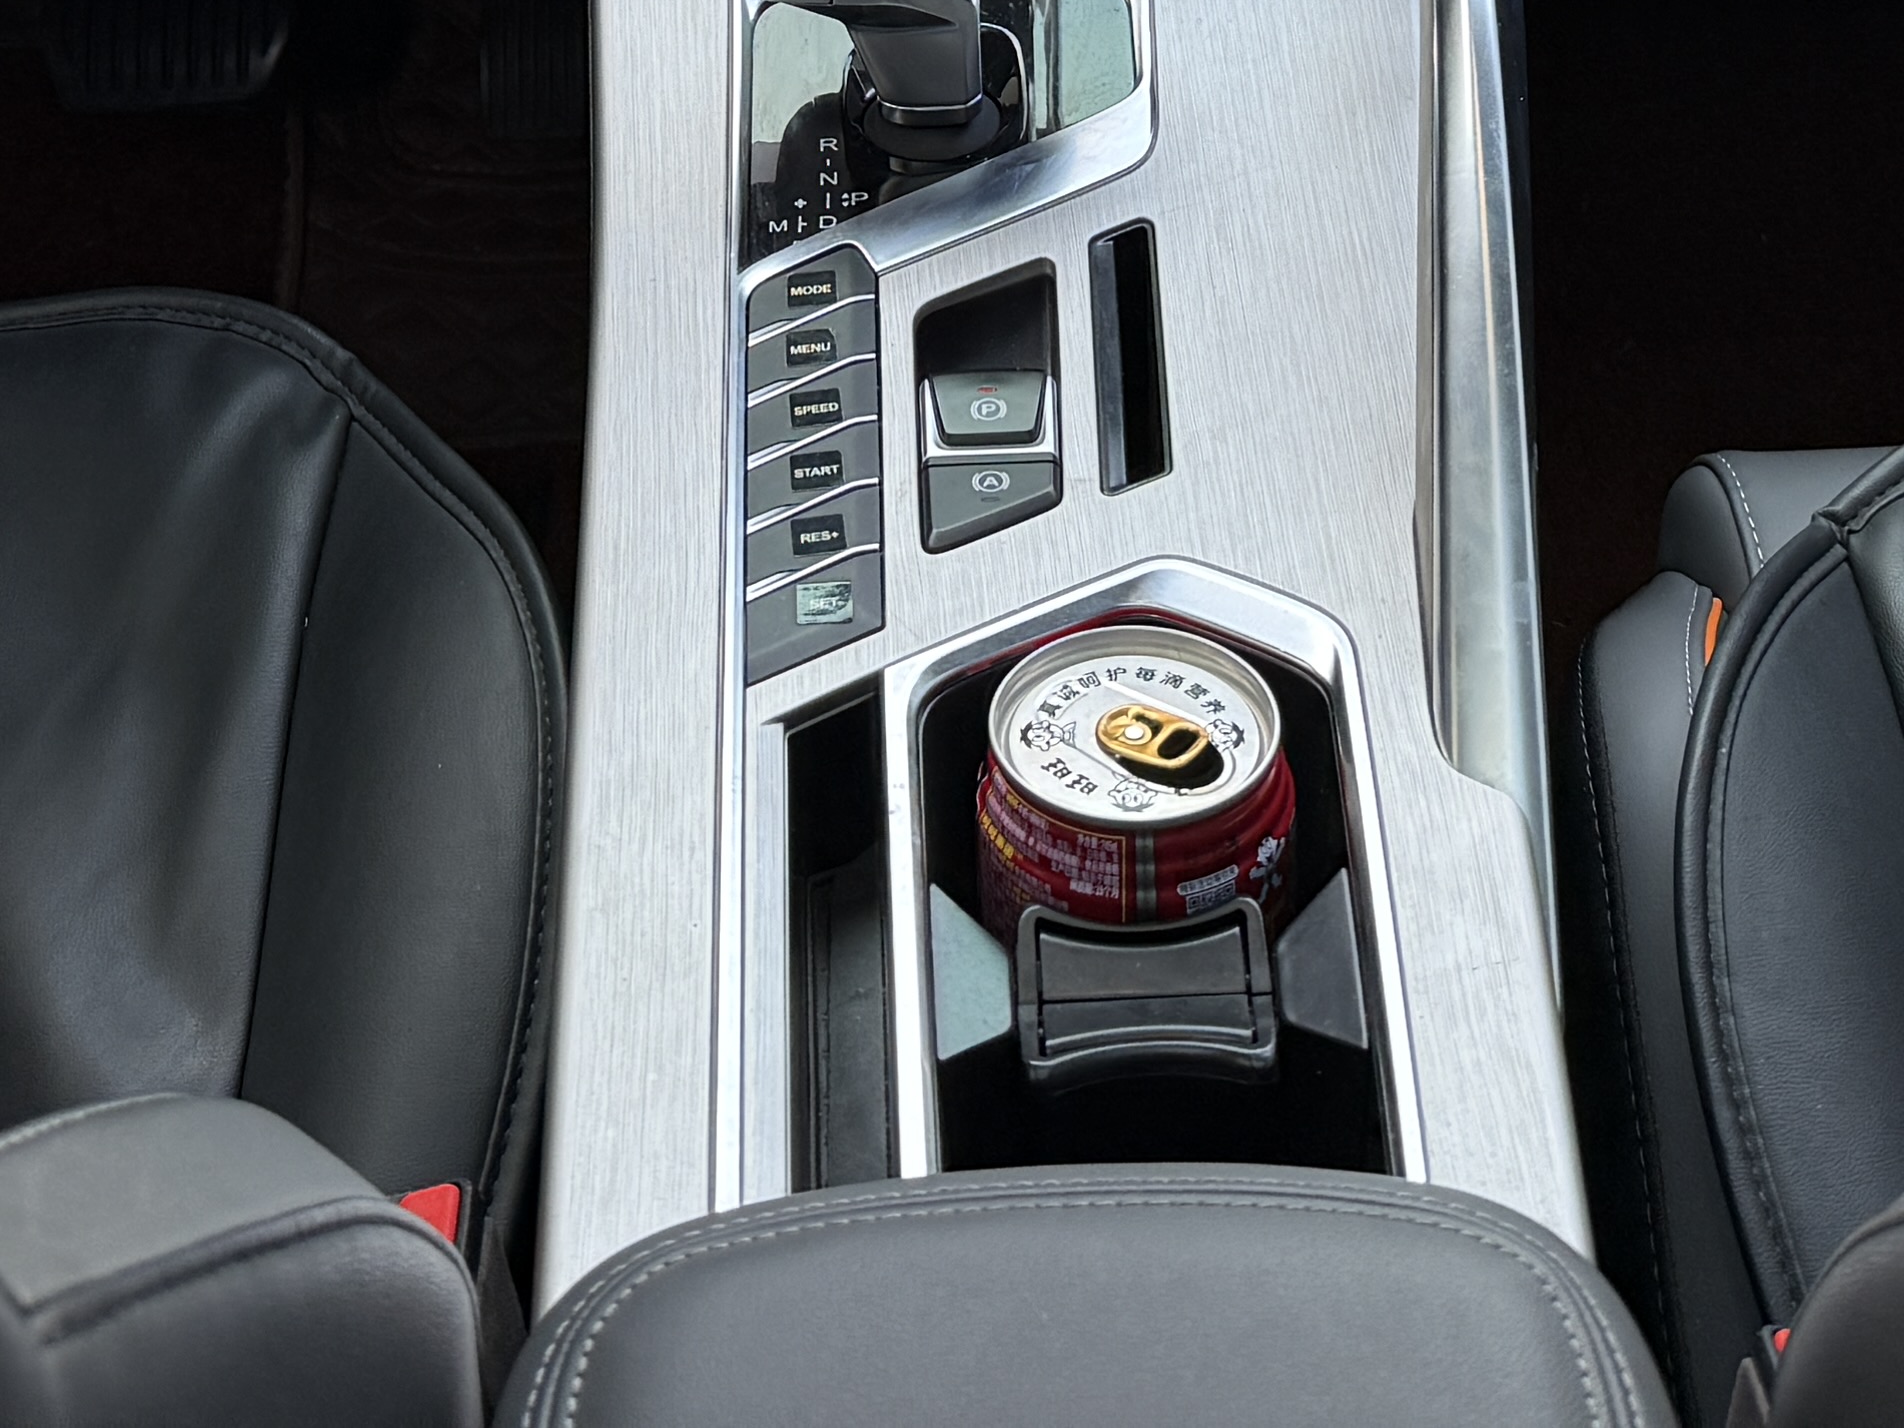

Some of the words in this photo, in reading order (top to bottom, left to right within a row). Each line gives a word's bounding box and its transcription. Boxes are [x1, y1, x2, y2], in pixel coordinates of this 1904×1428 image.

[820, 138, 839, 152] R
[820, 172, 838, 186] N
[851, 192, 869, 206] P
[769, 219, 788, 233] M
[819, 215, 837, 229] D
[790, 284, 832, 296] MODE
[790, 342, 831, 355] MENU
[794, 401, 839, 416] SPEED
[794, 464, 840, 479] START
[800, 530, 839, 544] RES+
[1040, 757, 1099, 796] 旺旺
